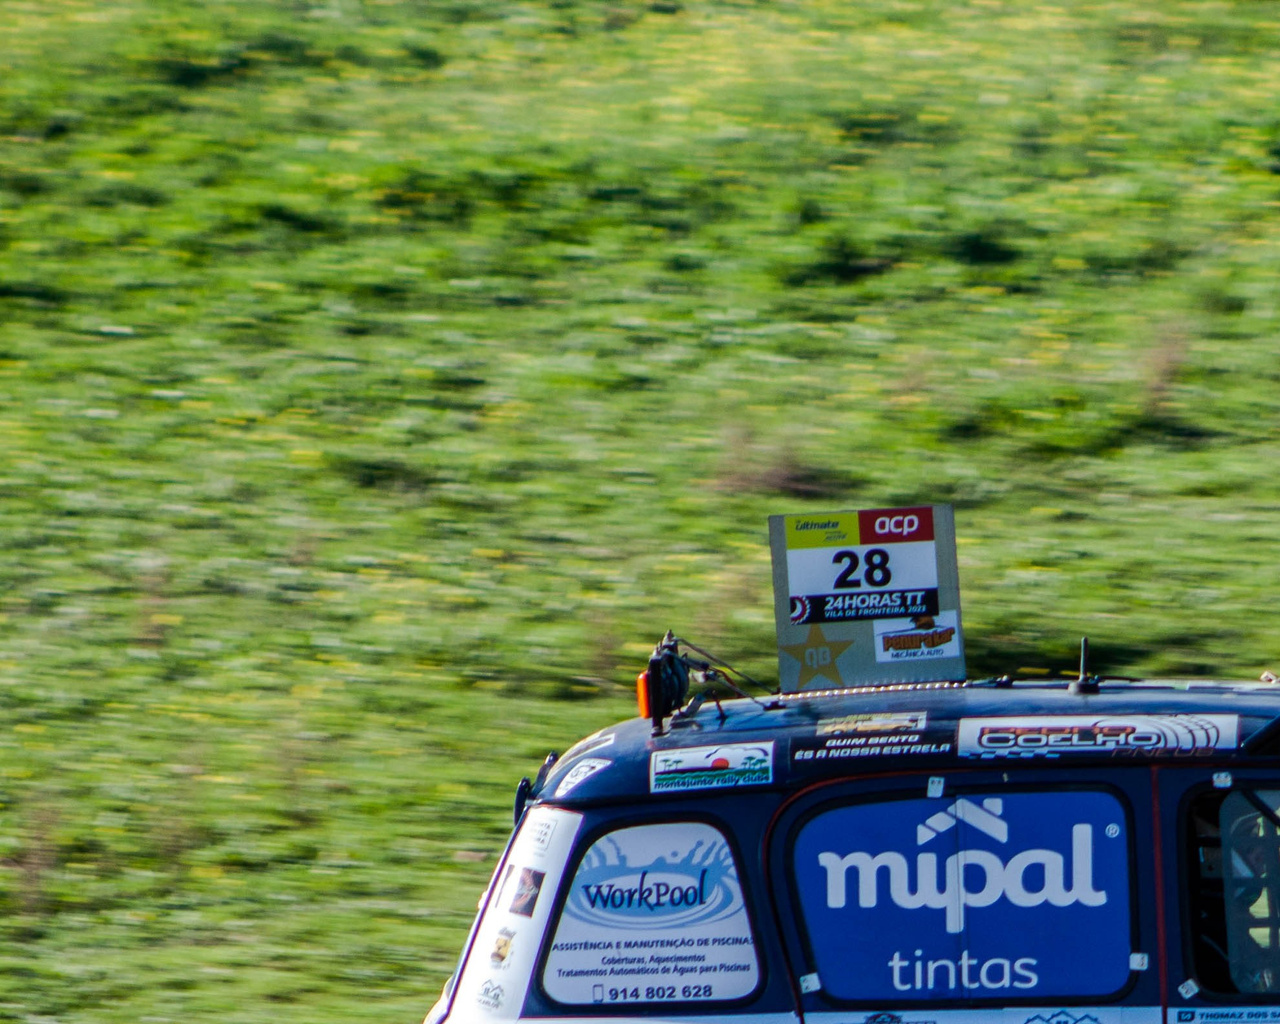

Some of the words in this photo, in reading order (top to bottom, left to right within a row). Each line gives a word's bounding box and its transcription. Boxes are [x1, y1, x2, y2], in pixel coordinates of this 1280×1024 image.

[875, 515, 919, 536] acp
[832, 548, 892, 590] 28
[859, 606, 906, 615] FRONTEIRA
[979, 732, 1161, 748] COELHO
[882, 743, 950, 755] ESTRELA
[818, 824, 1107, 933] mipal
[582, 869, 707, 911] WorkPool
[553, 939, 613, 950] ASSISTÊNCIA
[615, 941, 622, 949] E
[624, 936, 694, 949] MANUTENÇÃO
[697, 938, 710, 947] DE
[661, 966, 672, 975] de
[888, 950, 1039, 990] tintas
[608, 987, 640, 1000] 914
[645, 986, 676, 999] 802
[682, 984, 713, 998] 628
[1200, 1011, 1244, 1020] THOMAZ
[1247, 1011, 1268, 1019] DOS
